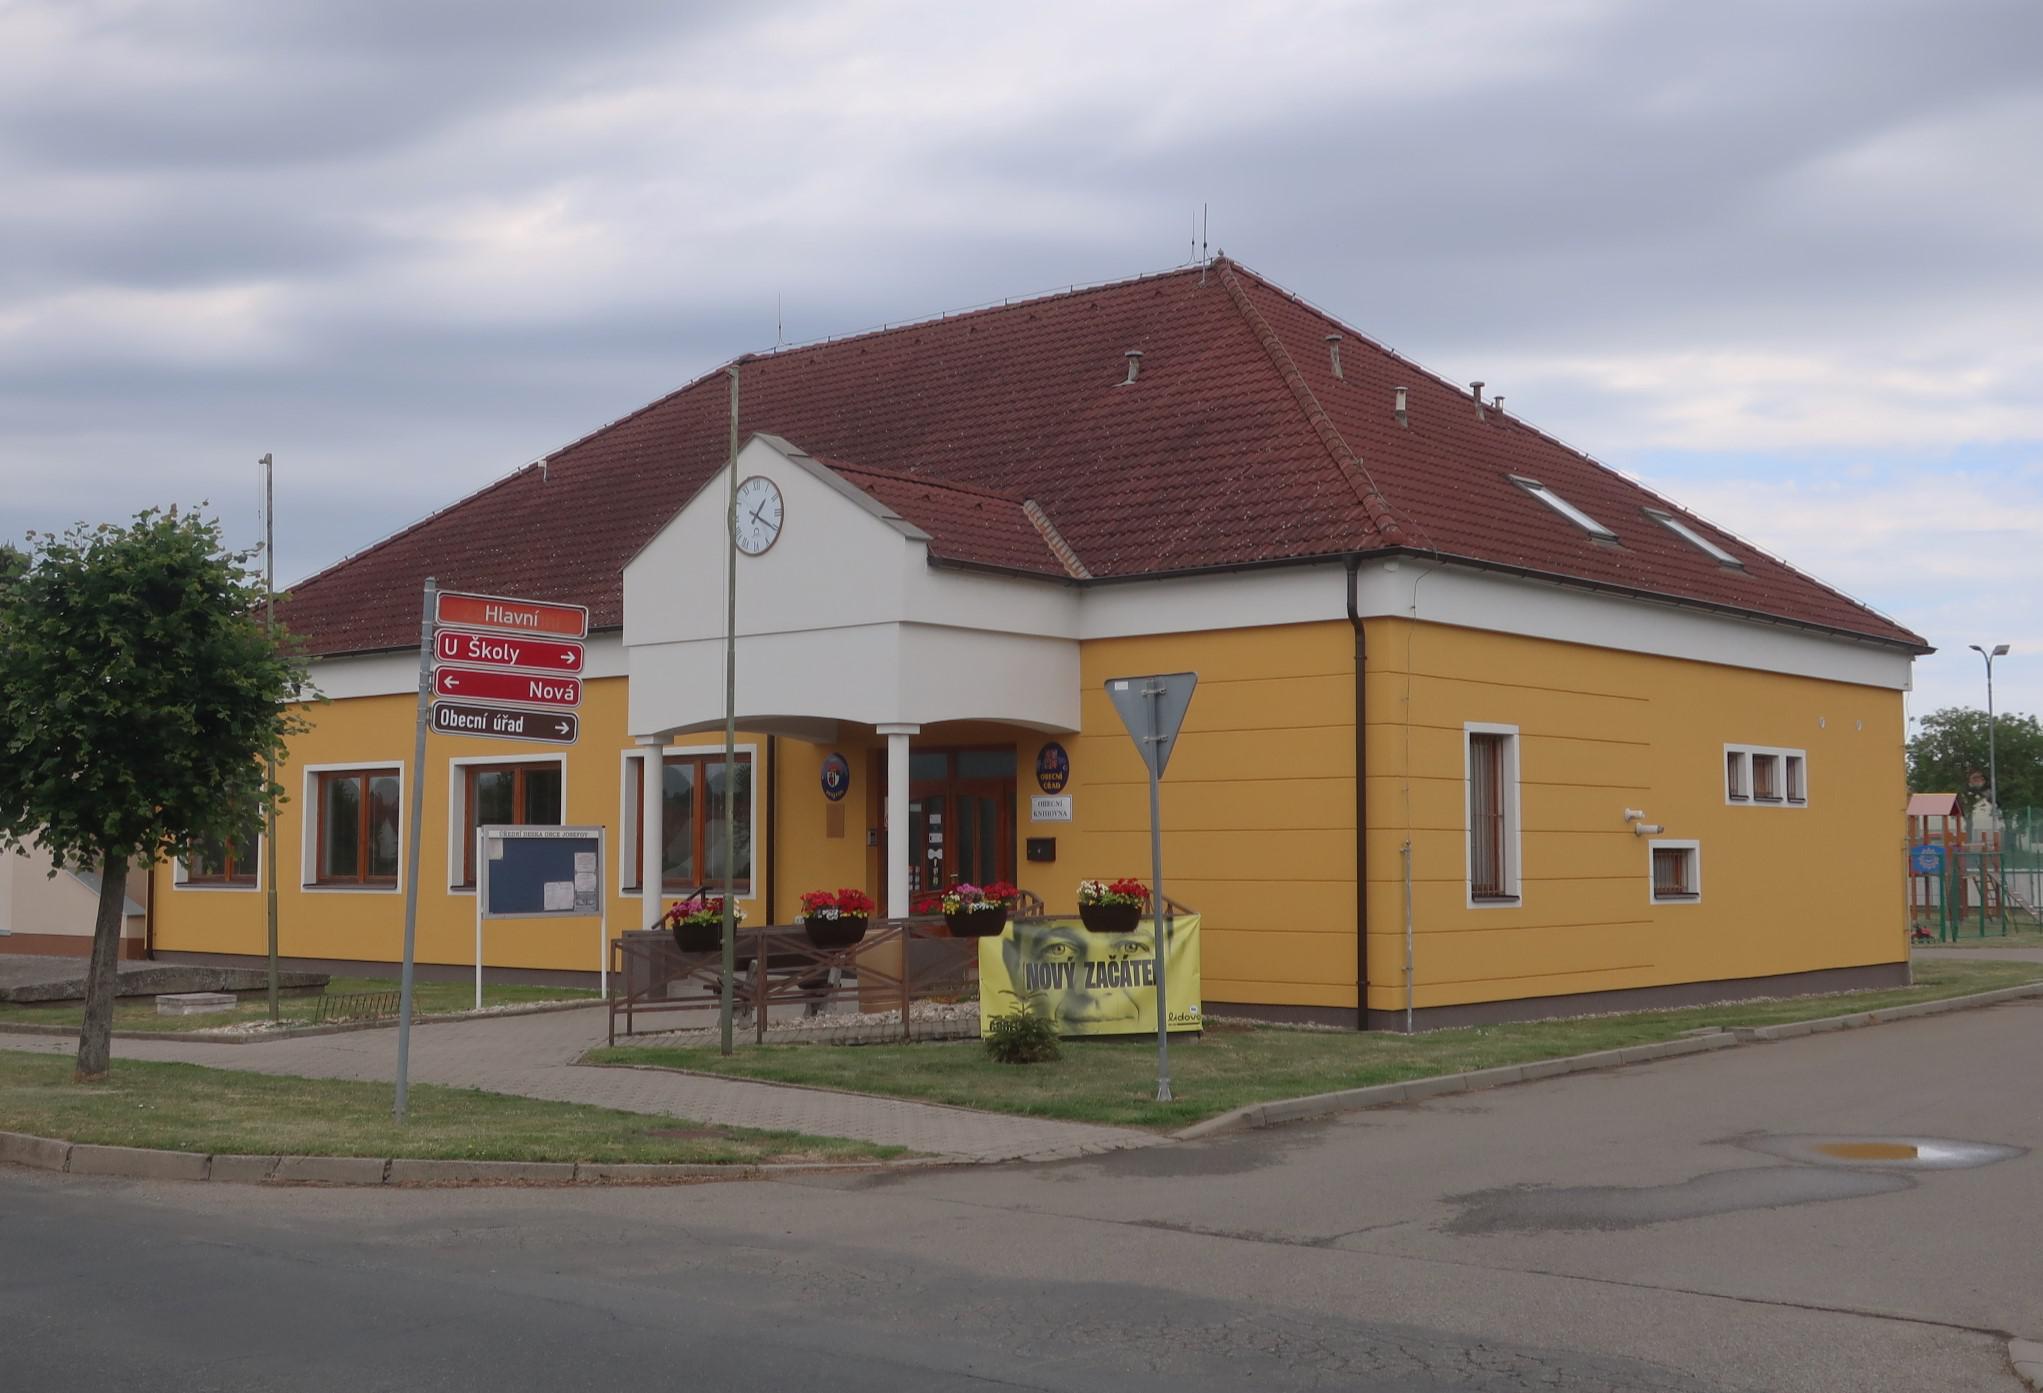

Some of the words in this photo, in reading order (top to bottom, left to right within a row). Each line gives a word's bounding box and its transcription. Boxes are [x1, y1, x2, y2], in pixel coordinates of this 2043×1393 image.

[485, 605, 540, 627] Hlavní
[444, 638, 458, 655] U
[468, 635, 520, 665] Školy
[529, 681, 574, 701] Nová
[440, 708, 488, 729] Obecní
[493, 714, 524, 733] úřad
[1025, 956, 1077, 990] NOVÝ
